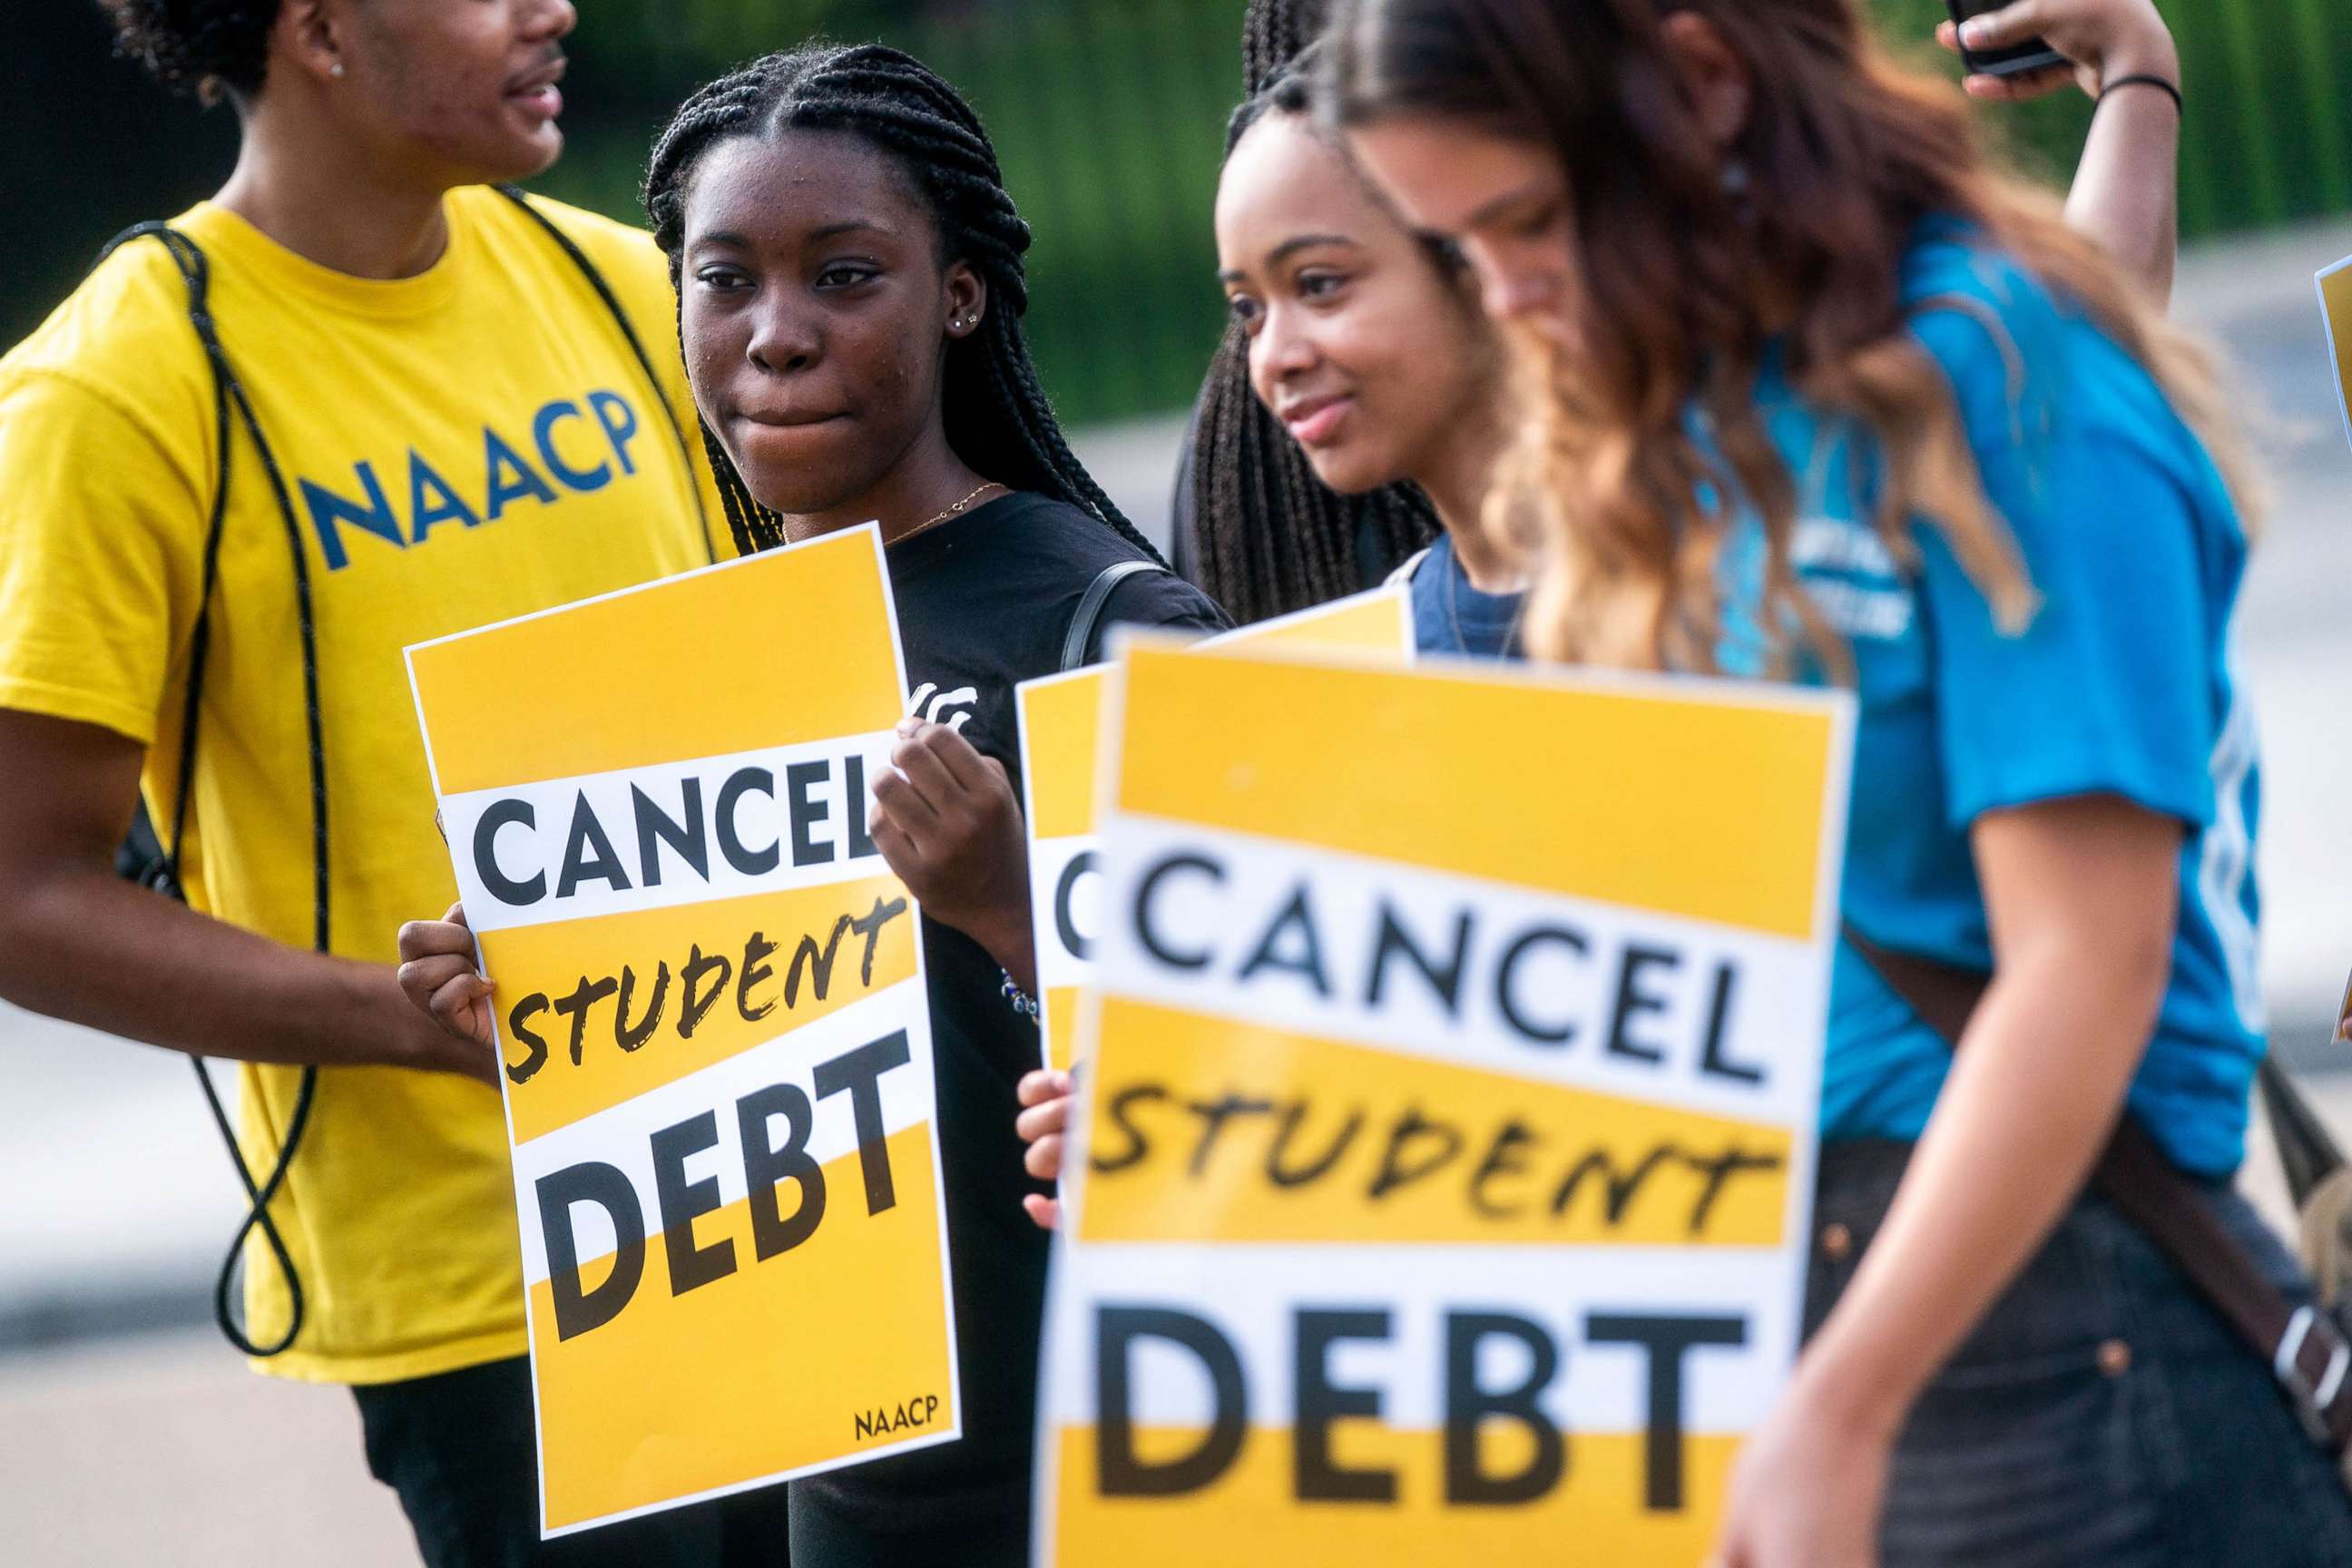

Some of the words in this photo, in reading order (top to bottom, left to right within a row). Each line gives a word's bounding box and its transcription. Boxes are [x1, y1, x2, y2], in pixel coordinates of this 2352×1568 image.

[298, 390, 638, 572] NAACP
[473, 755, 882, 906] CANCEL
[505, 897, 907, 1084] STUDENT
[1132, 849, 1766, 1085] CANCEL
[534, 1026, 911, 1343] DEBT
[1090, 1084, 1784, 1232] STUDENT
[854, 1395, 938, 1441] NAACP
[1095, 1305, 1746, 1512] DEBT
